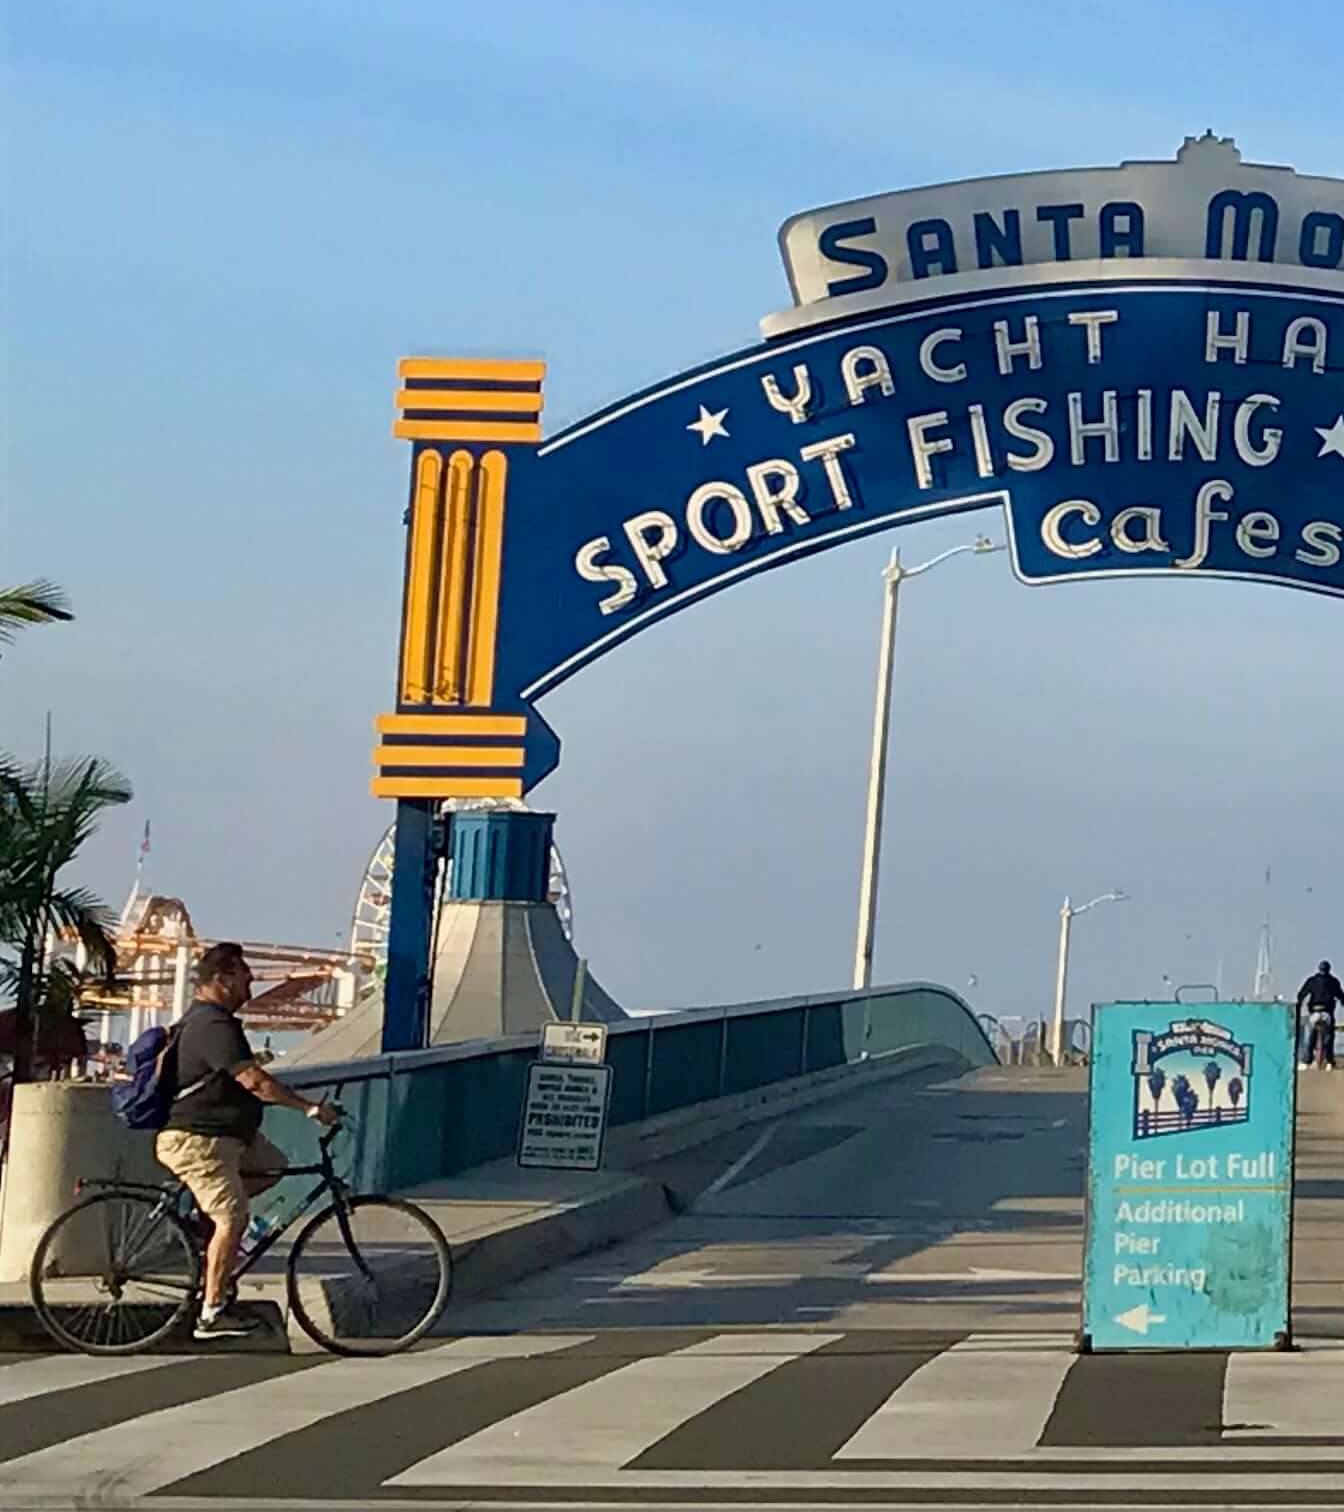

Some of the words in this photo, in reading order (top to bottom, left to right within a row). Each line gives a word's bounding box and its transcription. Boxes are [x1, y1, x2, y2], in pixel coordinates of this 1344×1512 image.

[818, 200, 1146, 291] SANTA
[761, 309, 1120, 424] YACHT
[575, 432, 856, 616] SPORT
[907, 388, 1285, 490] FISHING
[1114, 1153, 1167, 1180] Pier
[1175, 1153, 1219, 1180] Lot
[1226, 1151, 1276, 1180] Full
[1115, 1199, 1244, 1224] Additional
[1113, 1232, 1161, 1255] Pier
[1113, 1263, 1206, 1292] Parking
